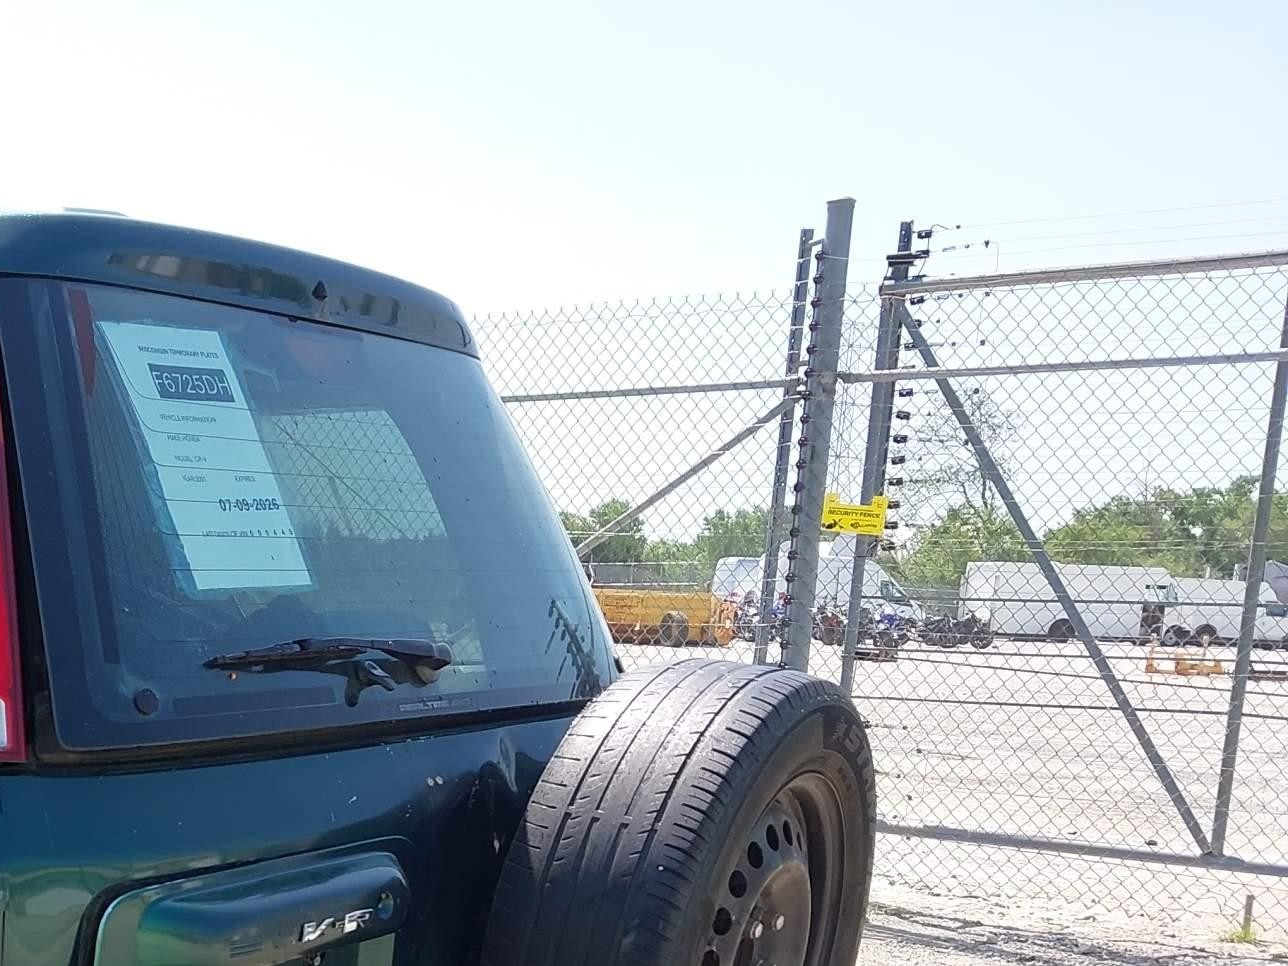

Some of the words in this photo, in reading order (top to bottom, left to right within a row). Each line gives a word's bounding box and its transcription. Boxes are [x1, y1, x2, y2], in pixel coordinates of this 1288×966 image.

[168, 348, 199, 358] TEMPORARY
[199, 351, 220, 359] PLATES
[152, 371, 232, 396] F6725DH
[218, 498, 280, 512] 07-09-2026
[828, 509, 859, 518] SECURITY
[859, 511, 881, 519] FENCE
